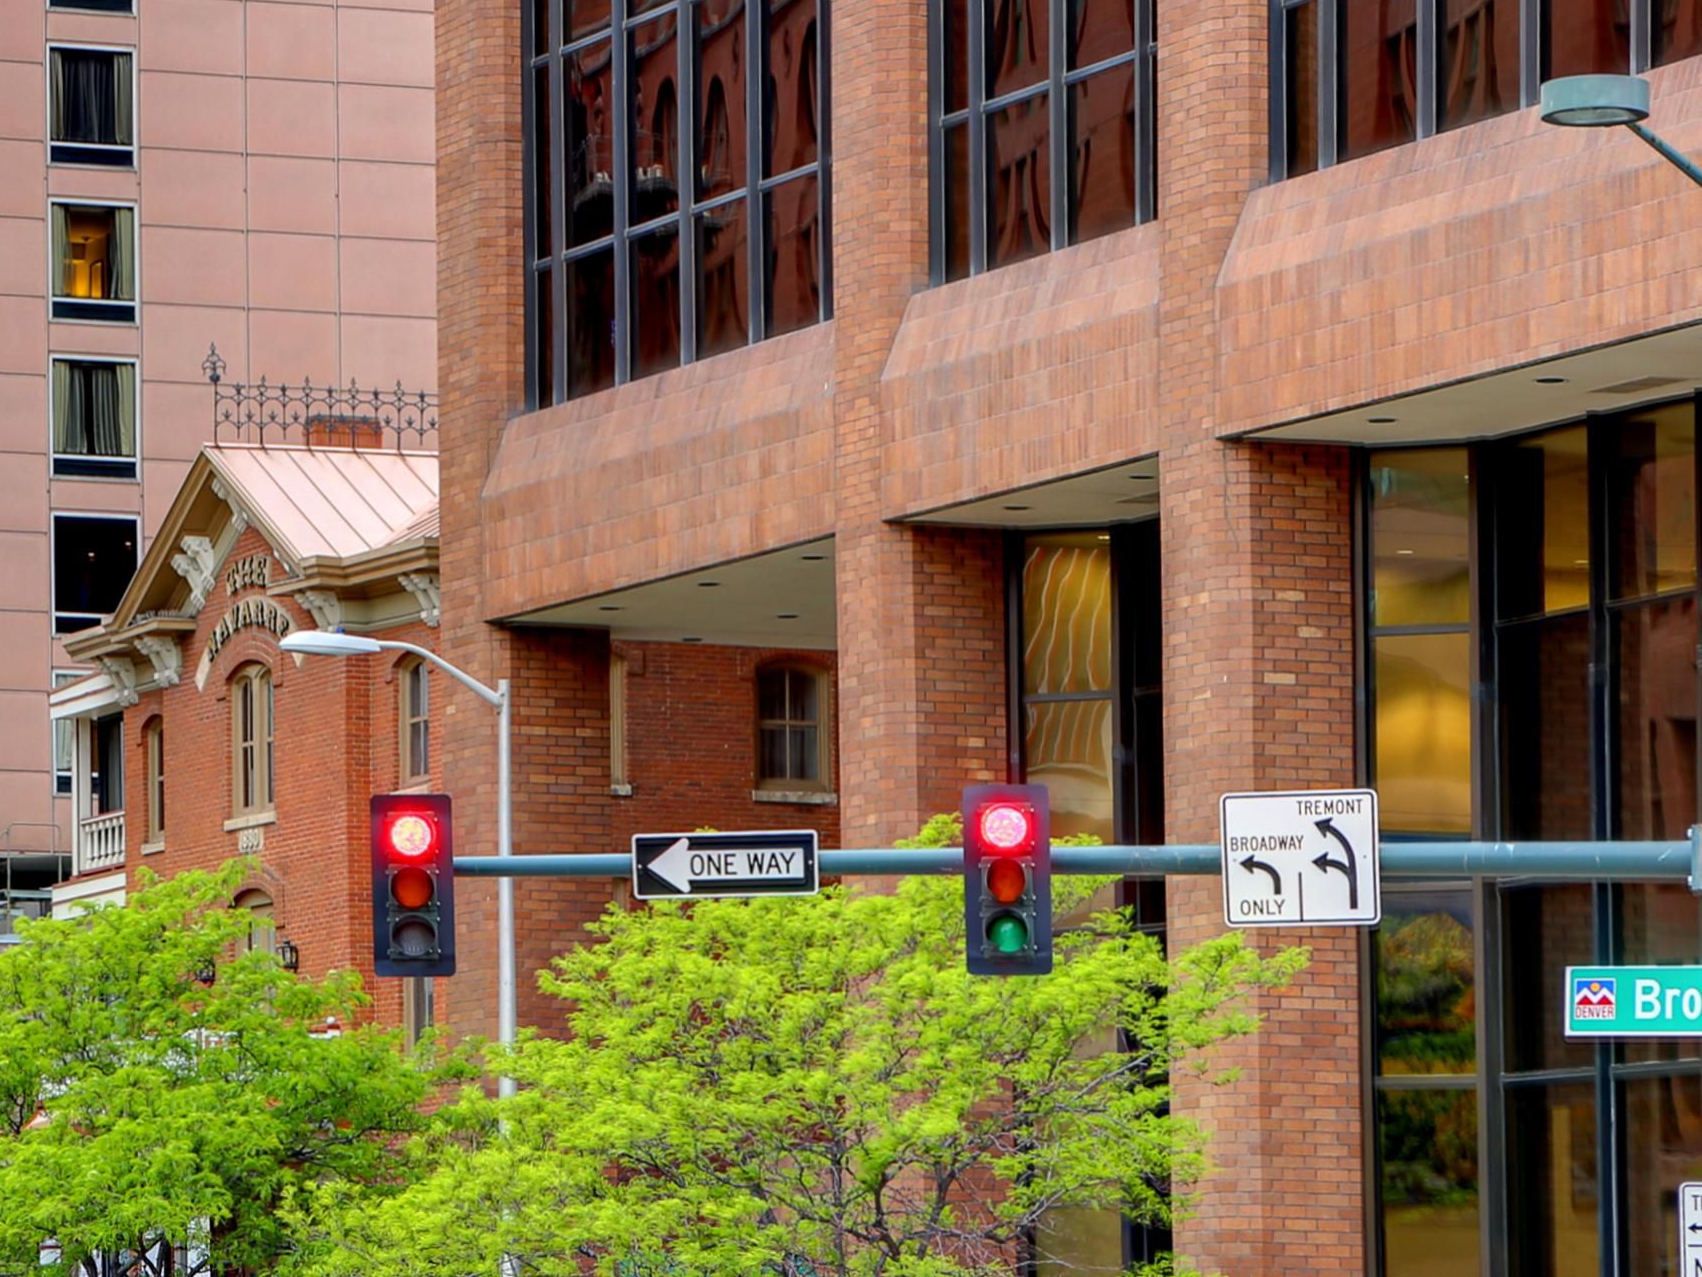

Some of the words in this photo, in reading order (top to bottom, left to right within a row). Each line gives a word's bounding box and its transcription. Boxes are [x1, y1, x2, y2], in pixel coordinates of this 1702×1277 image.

[226, 556, 267, 596] THE
[1296, 798, 1363, 816] TREMONT
[1230, 835, 1304, 852] BROADWAY
[689, 853, 738, 876] ONE
[747, 852, 796, 875] WAY
[1240, 899, 1285, 916] ONLY
[1634, 978, 1702, 1020] Bro
[1575, 1006, 1615, 1019] DENVER
